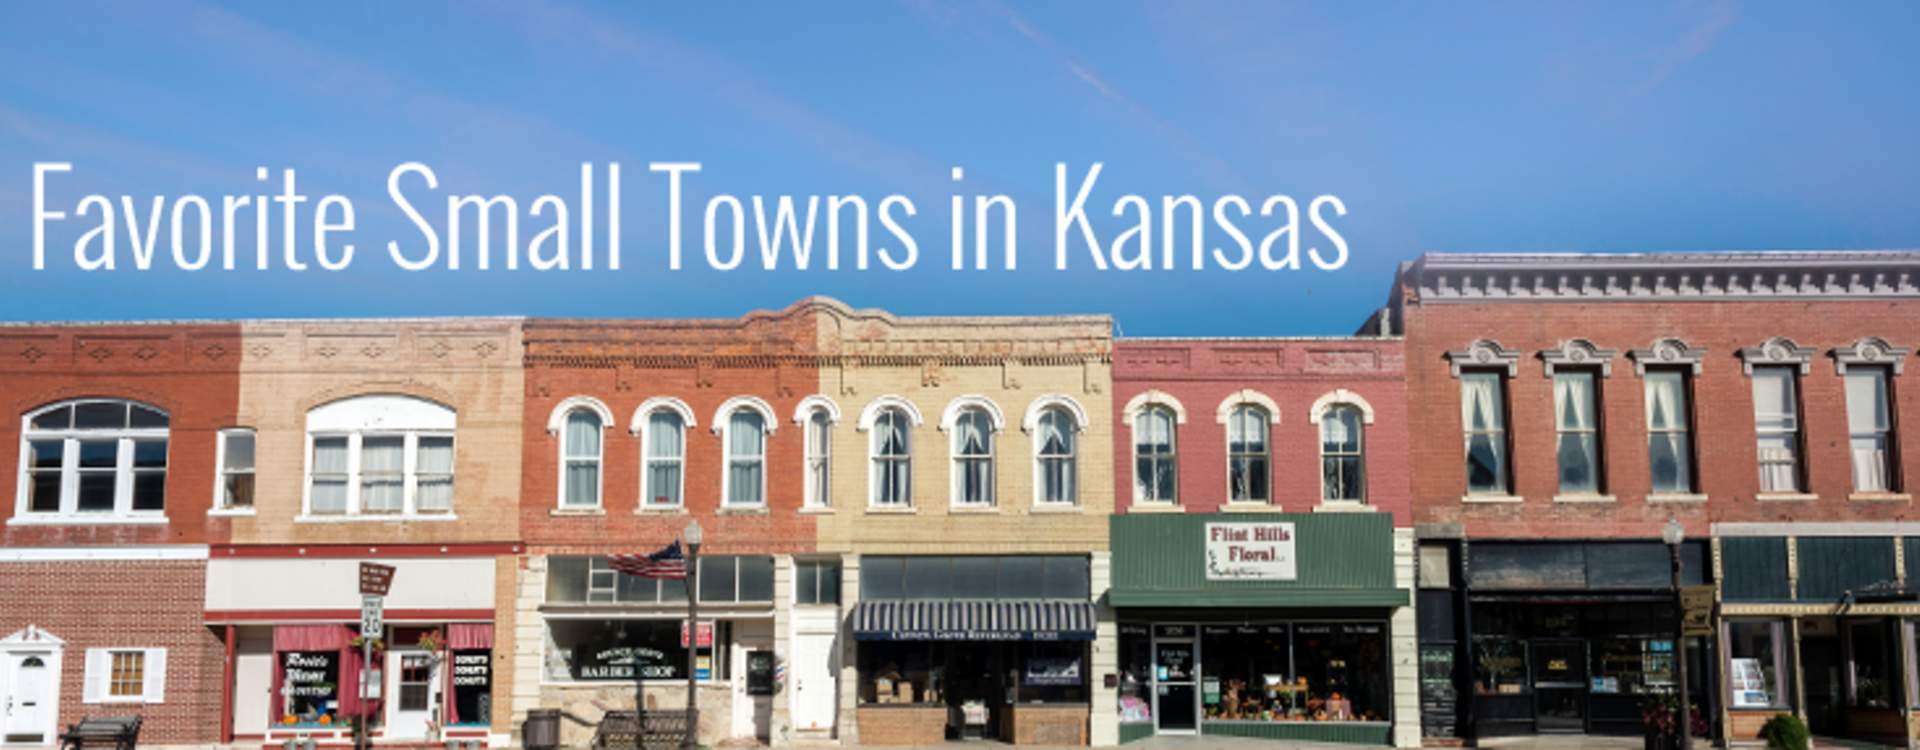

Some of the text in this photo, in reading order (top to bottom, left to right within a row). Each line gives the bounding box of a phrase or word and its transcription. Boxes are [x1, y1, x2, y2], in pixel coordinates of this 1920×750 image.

[1210, 526, 1291, 542] Flint Hills
[1228, 545, 1276, 562] Floral
[364, 618, 379, 633] 20
[285, 668, 327, 683] Diner
[581, 666, 676, 678] BARBER SHOP
